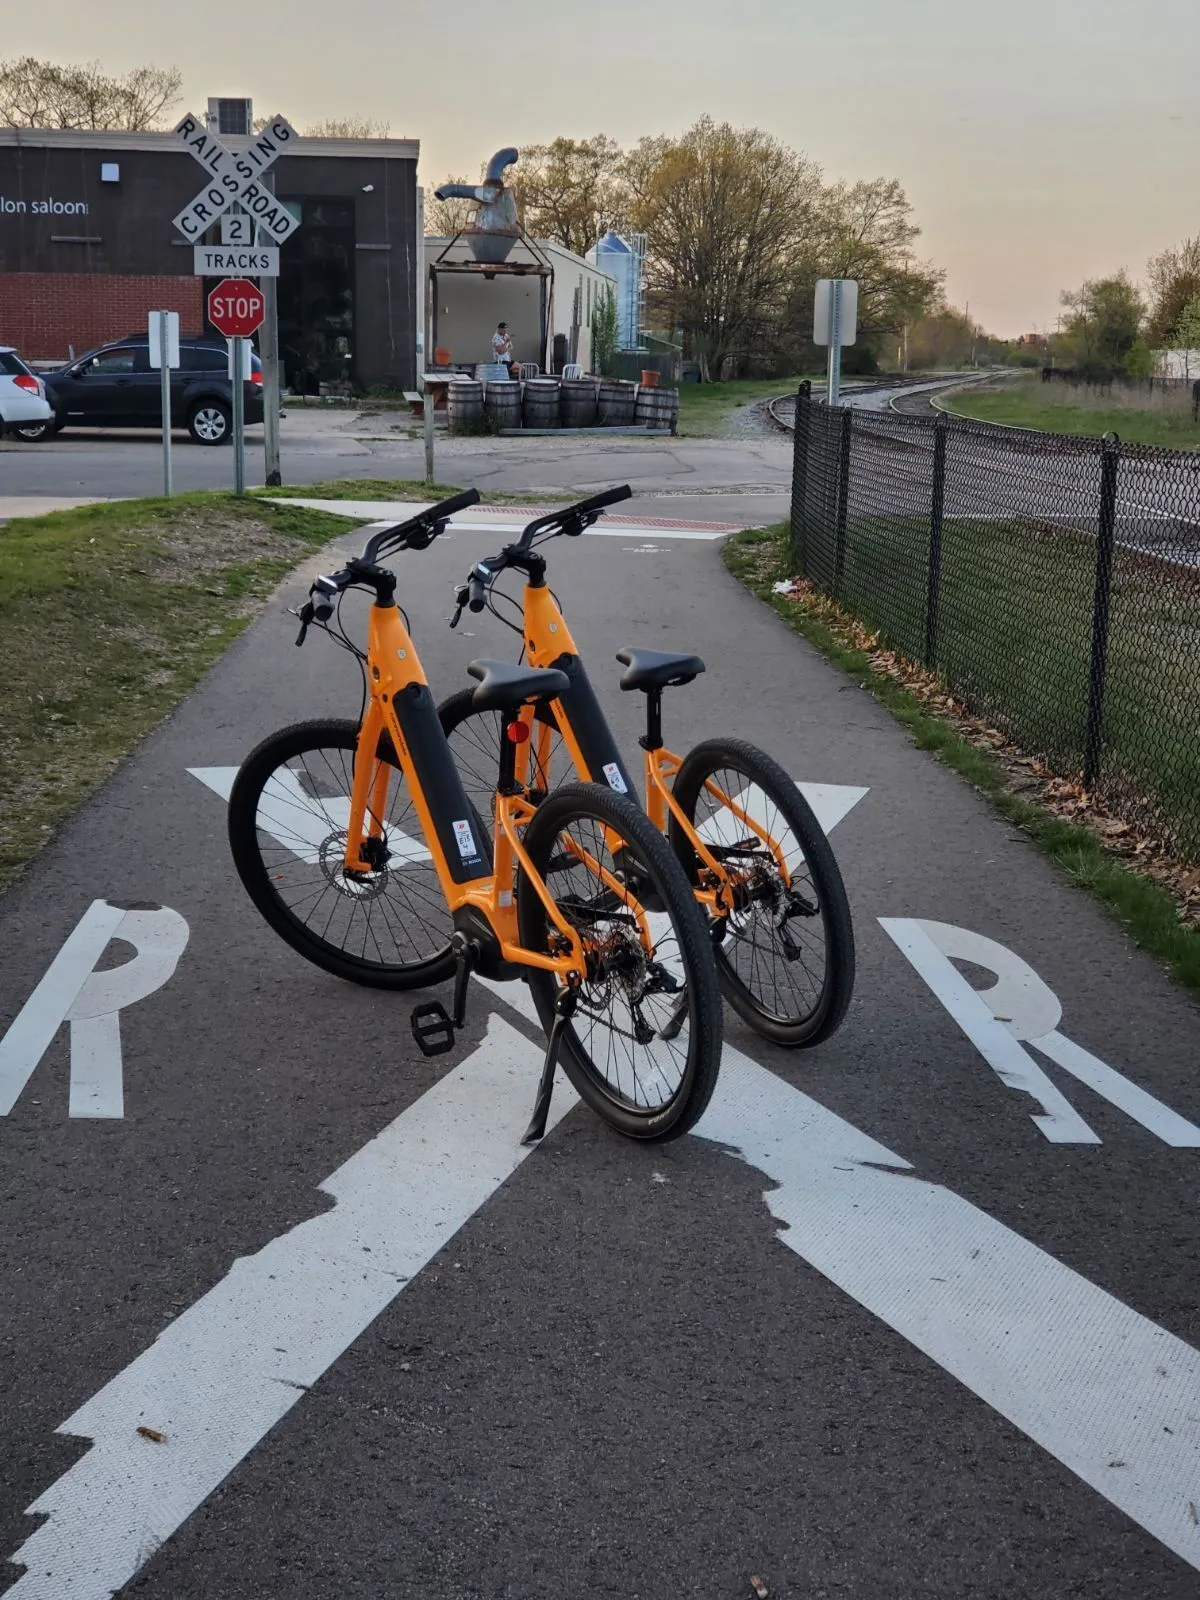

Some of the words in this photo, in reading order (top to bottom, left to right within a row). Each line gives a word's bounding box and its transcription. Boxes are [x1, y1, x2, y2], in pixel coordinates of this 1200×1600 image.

[180, 123, 290, 234] CROSSING
[0, 196, 26, 213] lon
[31, 196, 86, 215] saloon
[229, 220, 243, 239] 2
[204, 253, 270, 269] TRACKS
[213, 297, 261, 319] STOP
[0, 898, 190, 1119] R
[876, 916, 1200, 1147] R
